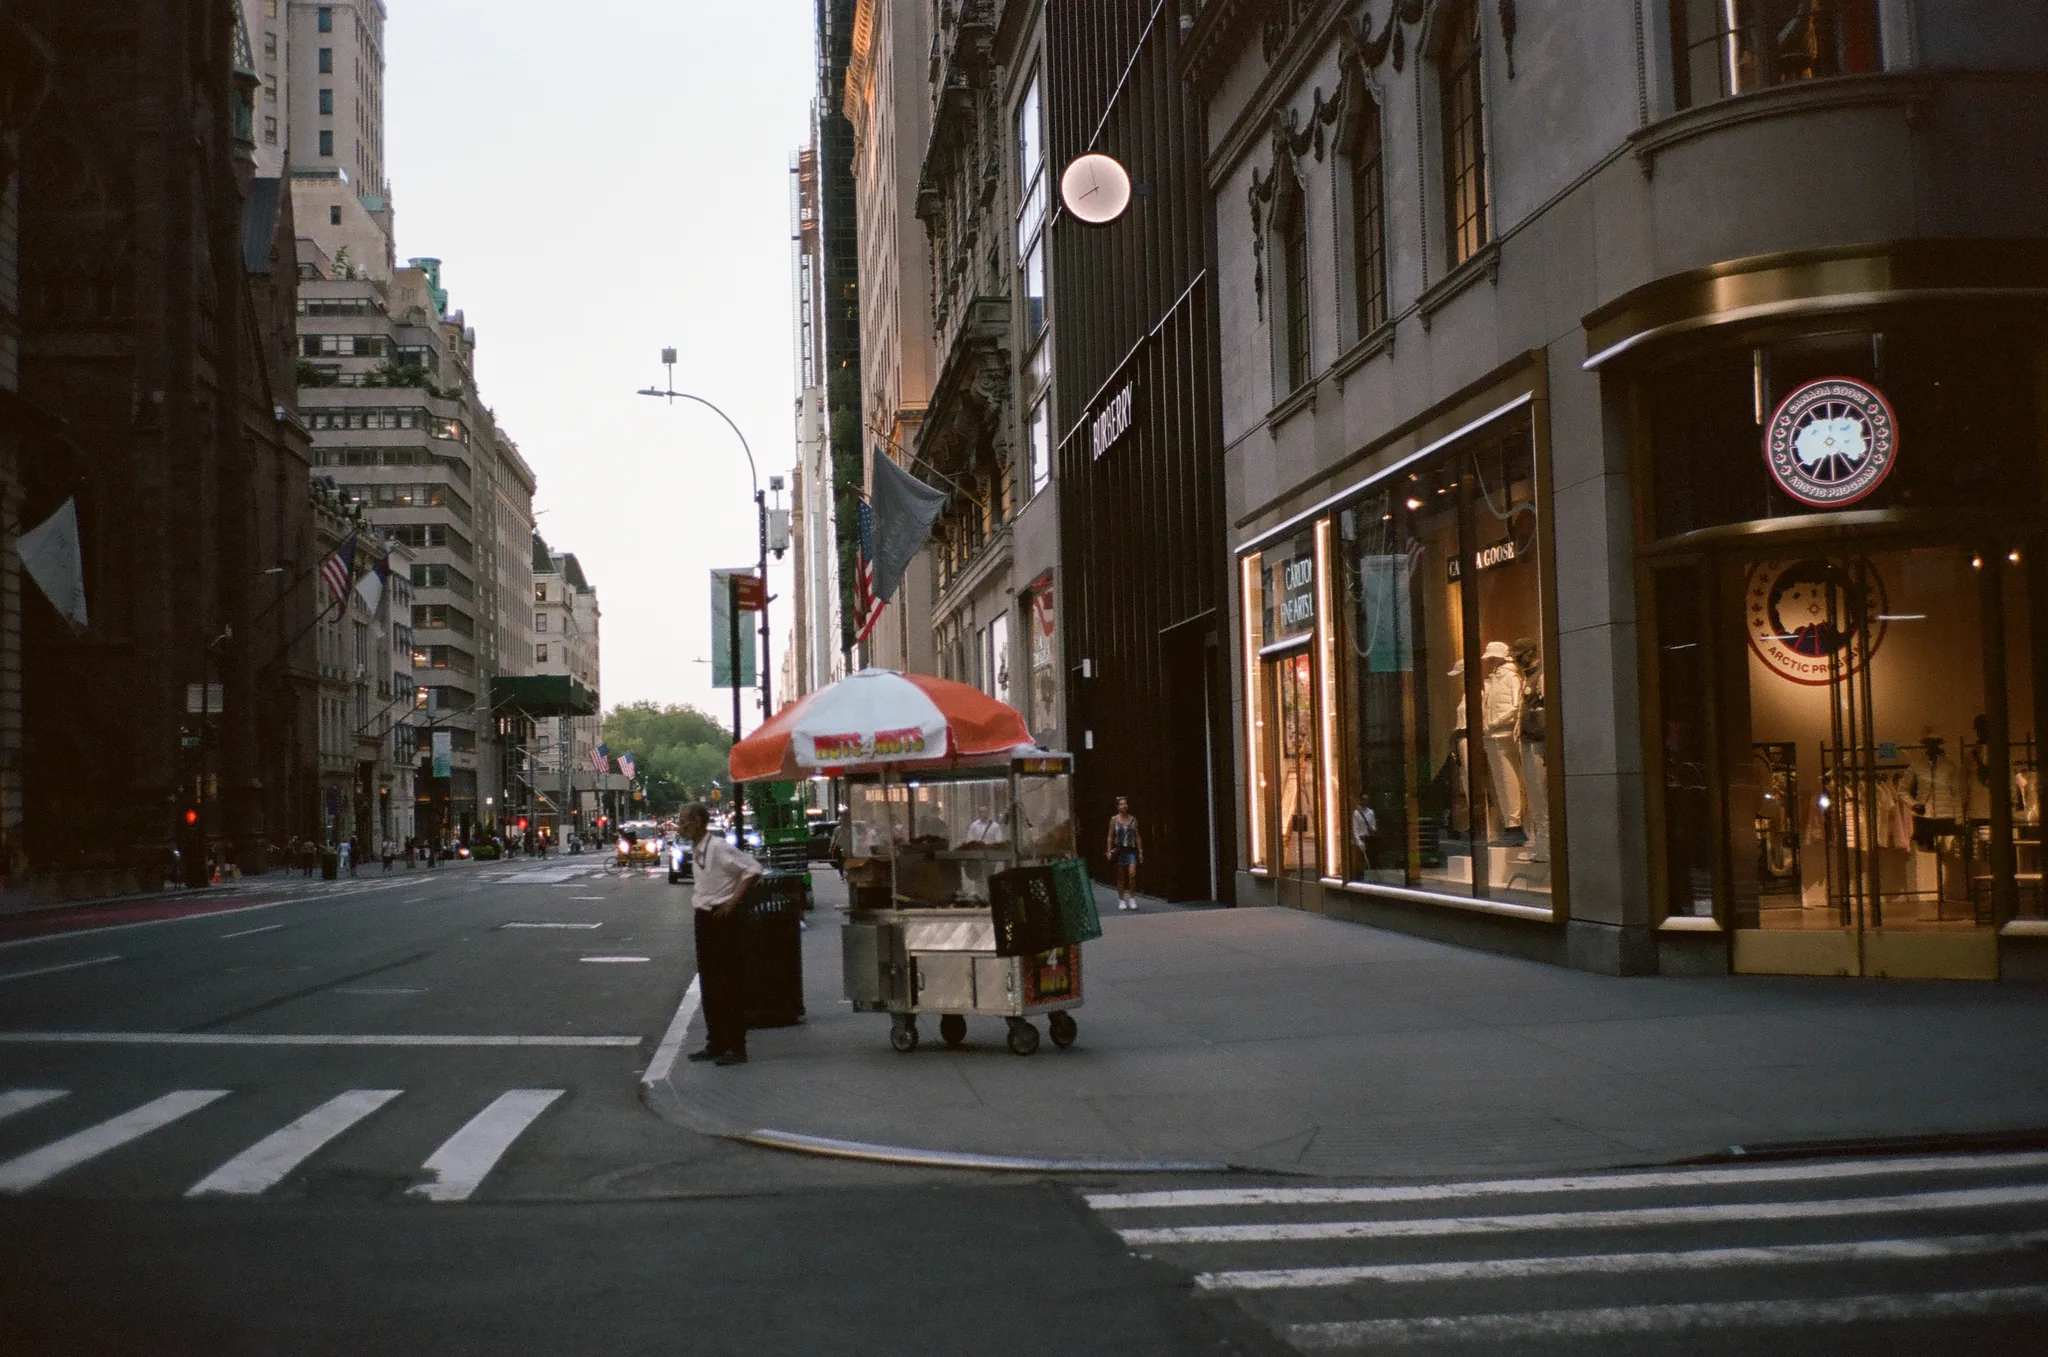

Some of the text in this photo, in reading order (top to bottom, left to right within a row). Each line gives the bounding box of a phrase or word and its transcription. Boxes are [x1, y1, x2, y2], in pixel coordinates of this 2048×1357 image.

[1789, 386, 1868, 414] CANADA GOOSE
[1093, 380, 1133, 461] BURBERRY
[1790, 466, 1877, 498] ARCTIC PROGRAM
[1484, 541, 1515, 567] GOOSE
[1293, 593, 1309, 622] ARTS
[1768, 646, 1809, 673] ARCTIC
